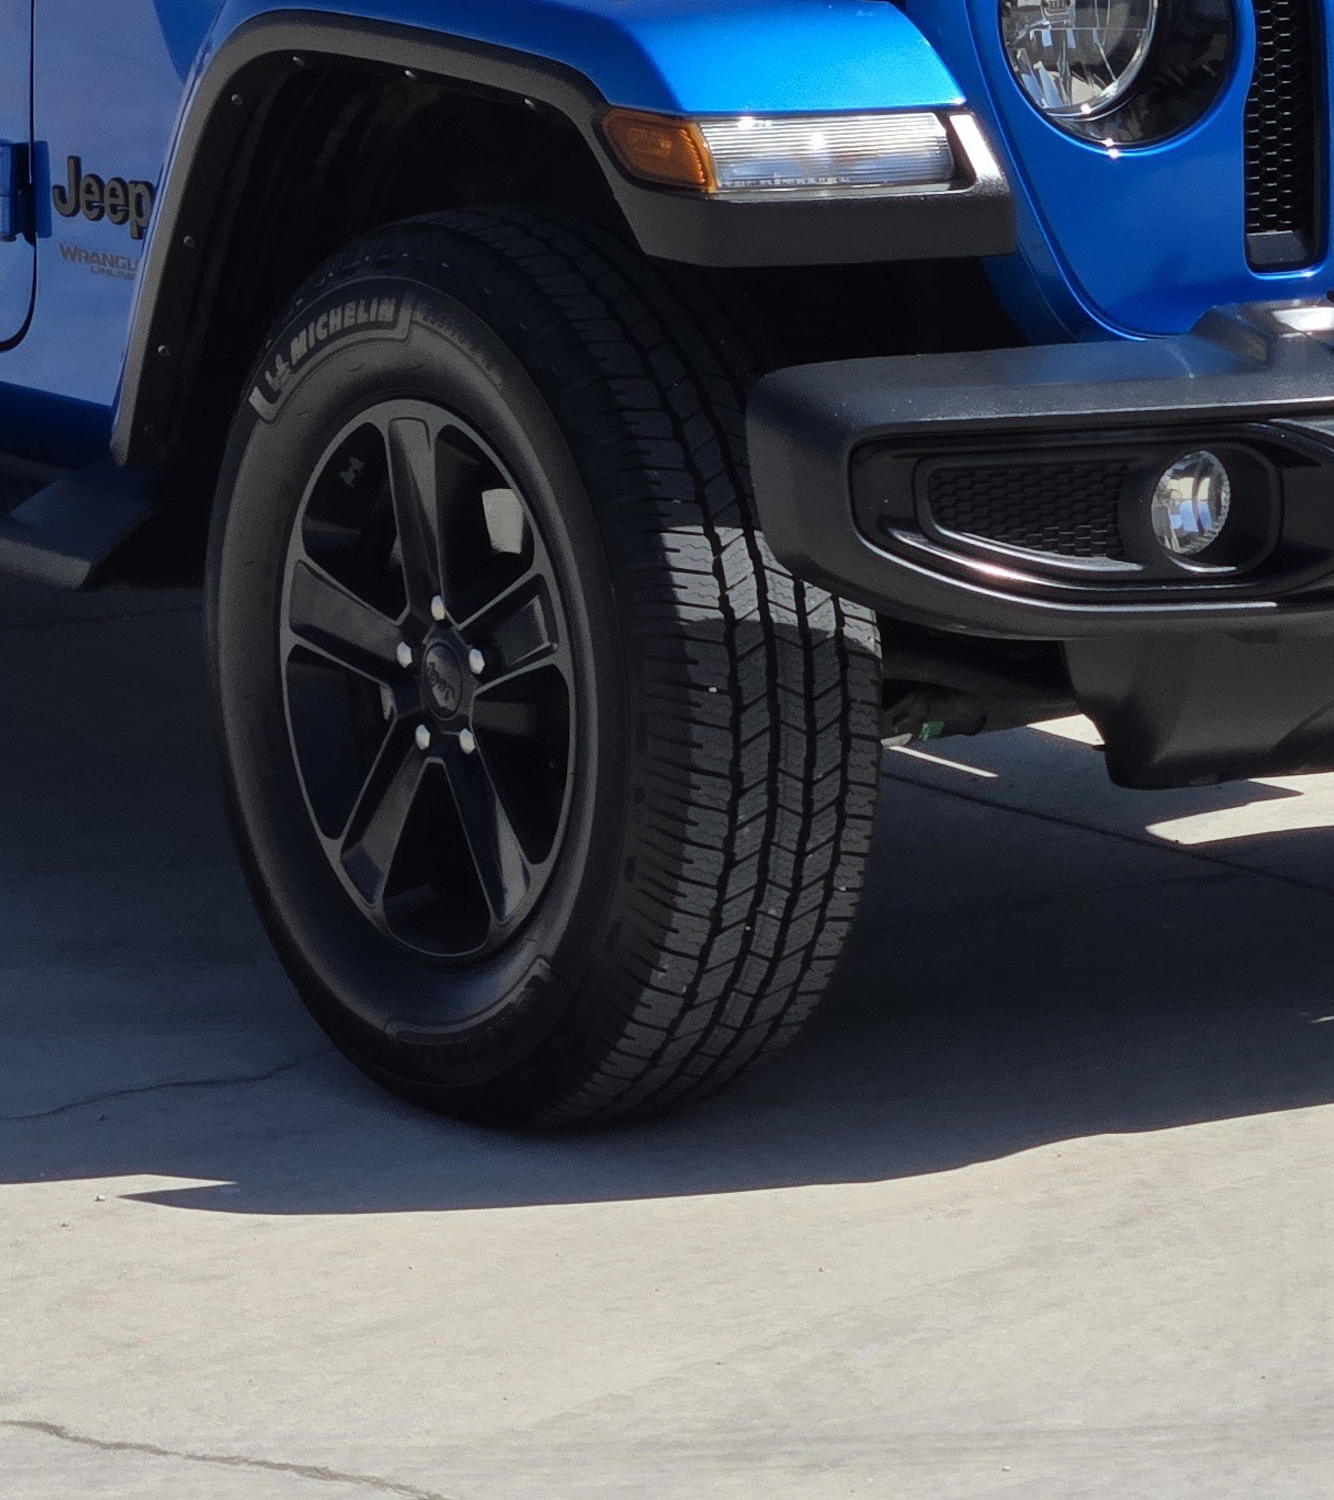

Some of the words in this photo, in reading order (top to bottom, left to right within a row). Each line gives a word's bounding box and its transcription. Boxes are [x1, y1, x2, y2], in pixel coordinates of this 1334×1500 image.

[52, 155, 156, 240] Jeep
[59, 242, 139, 271] WRANGL
[290, 297, 397, 366] MICHELIN
